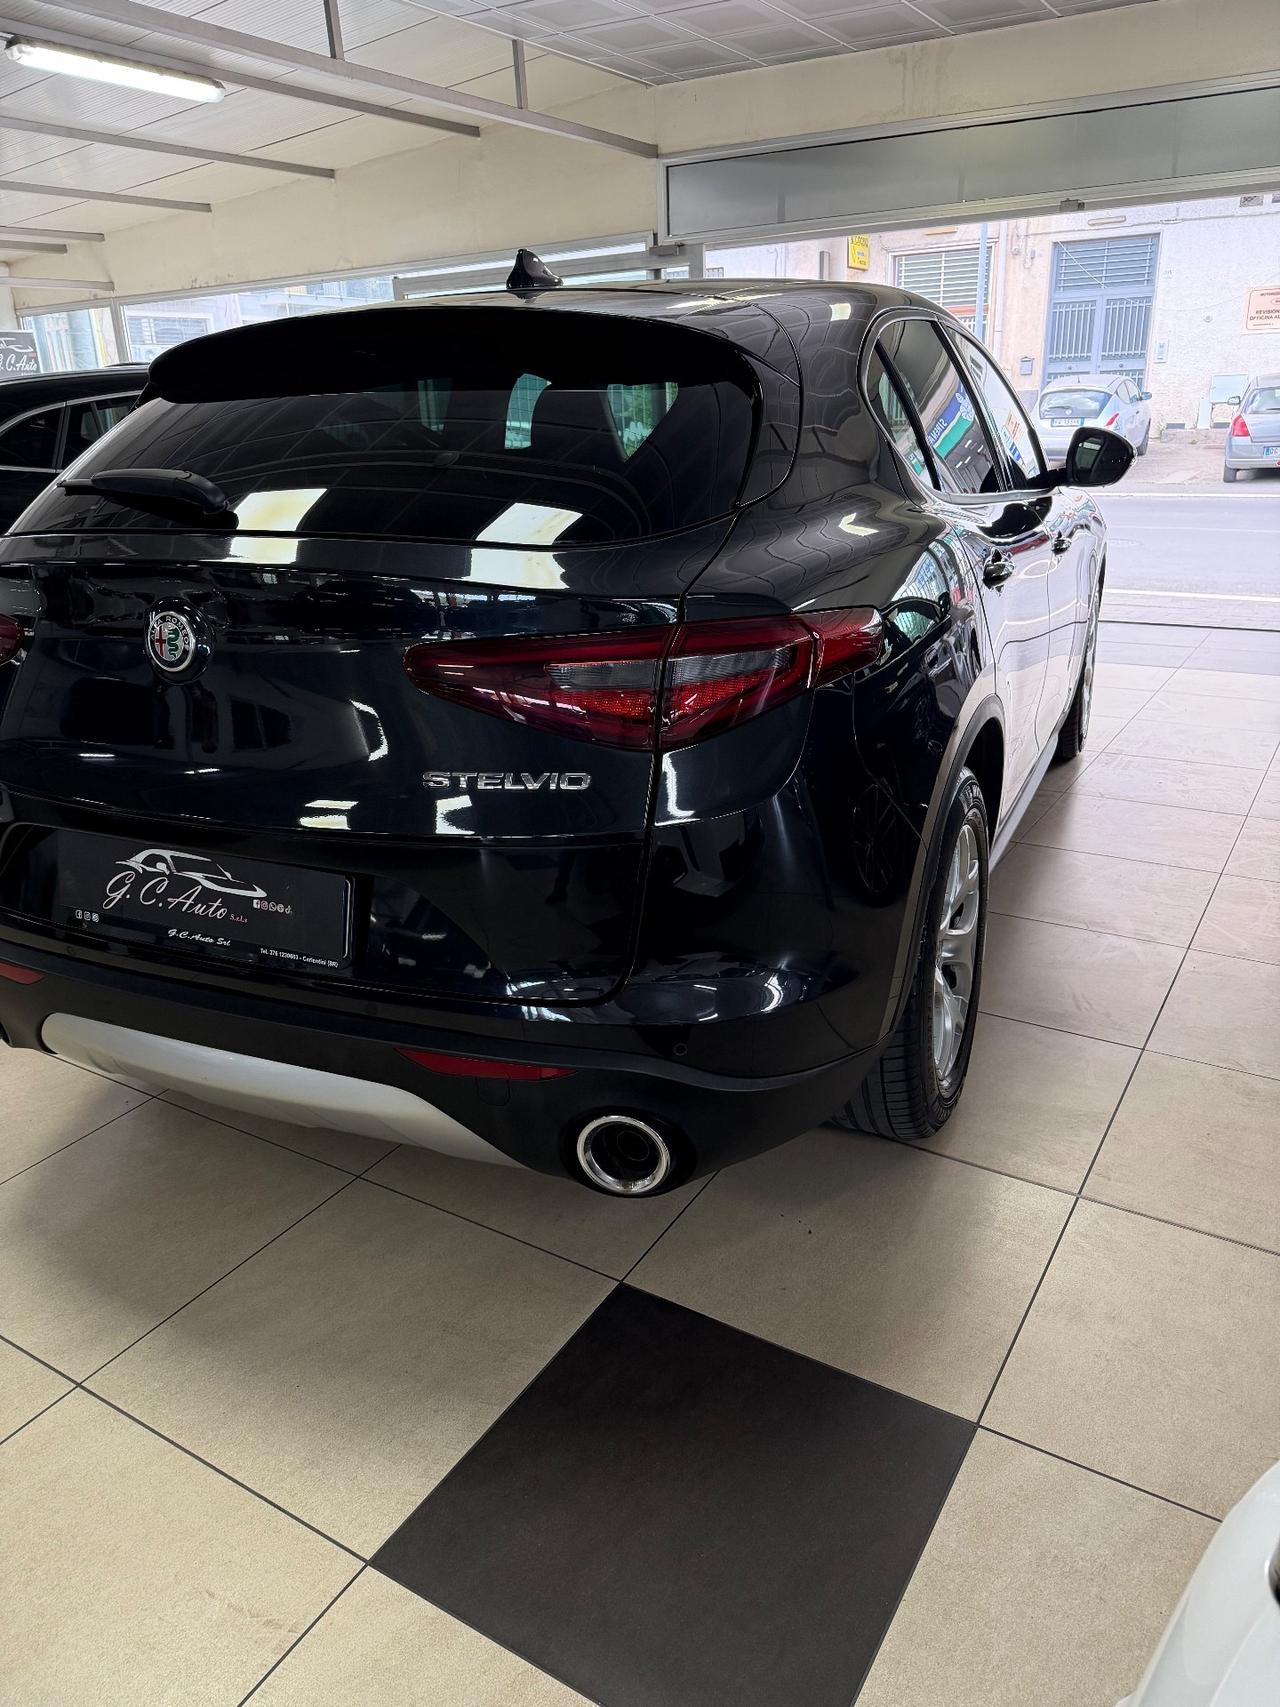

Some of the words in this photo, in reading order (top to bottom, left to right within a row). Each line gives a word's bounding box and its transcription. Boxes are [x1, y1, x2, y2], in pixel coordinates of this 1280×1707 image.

[165, 615, 189, 644] ROMEO
[422, 771, 592, 790] STELVIO
[216, 937, 231, 946] Srl
